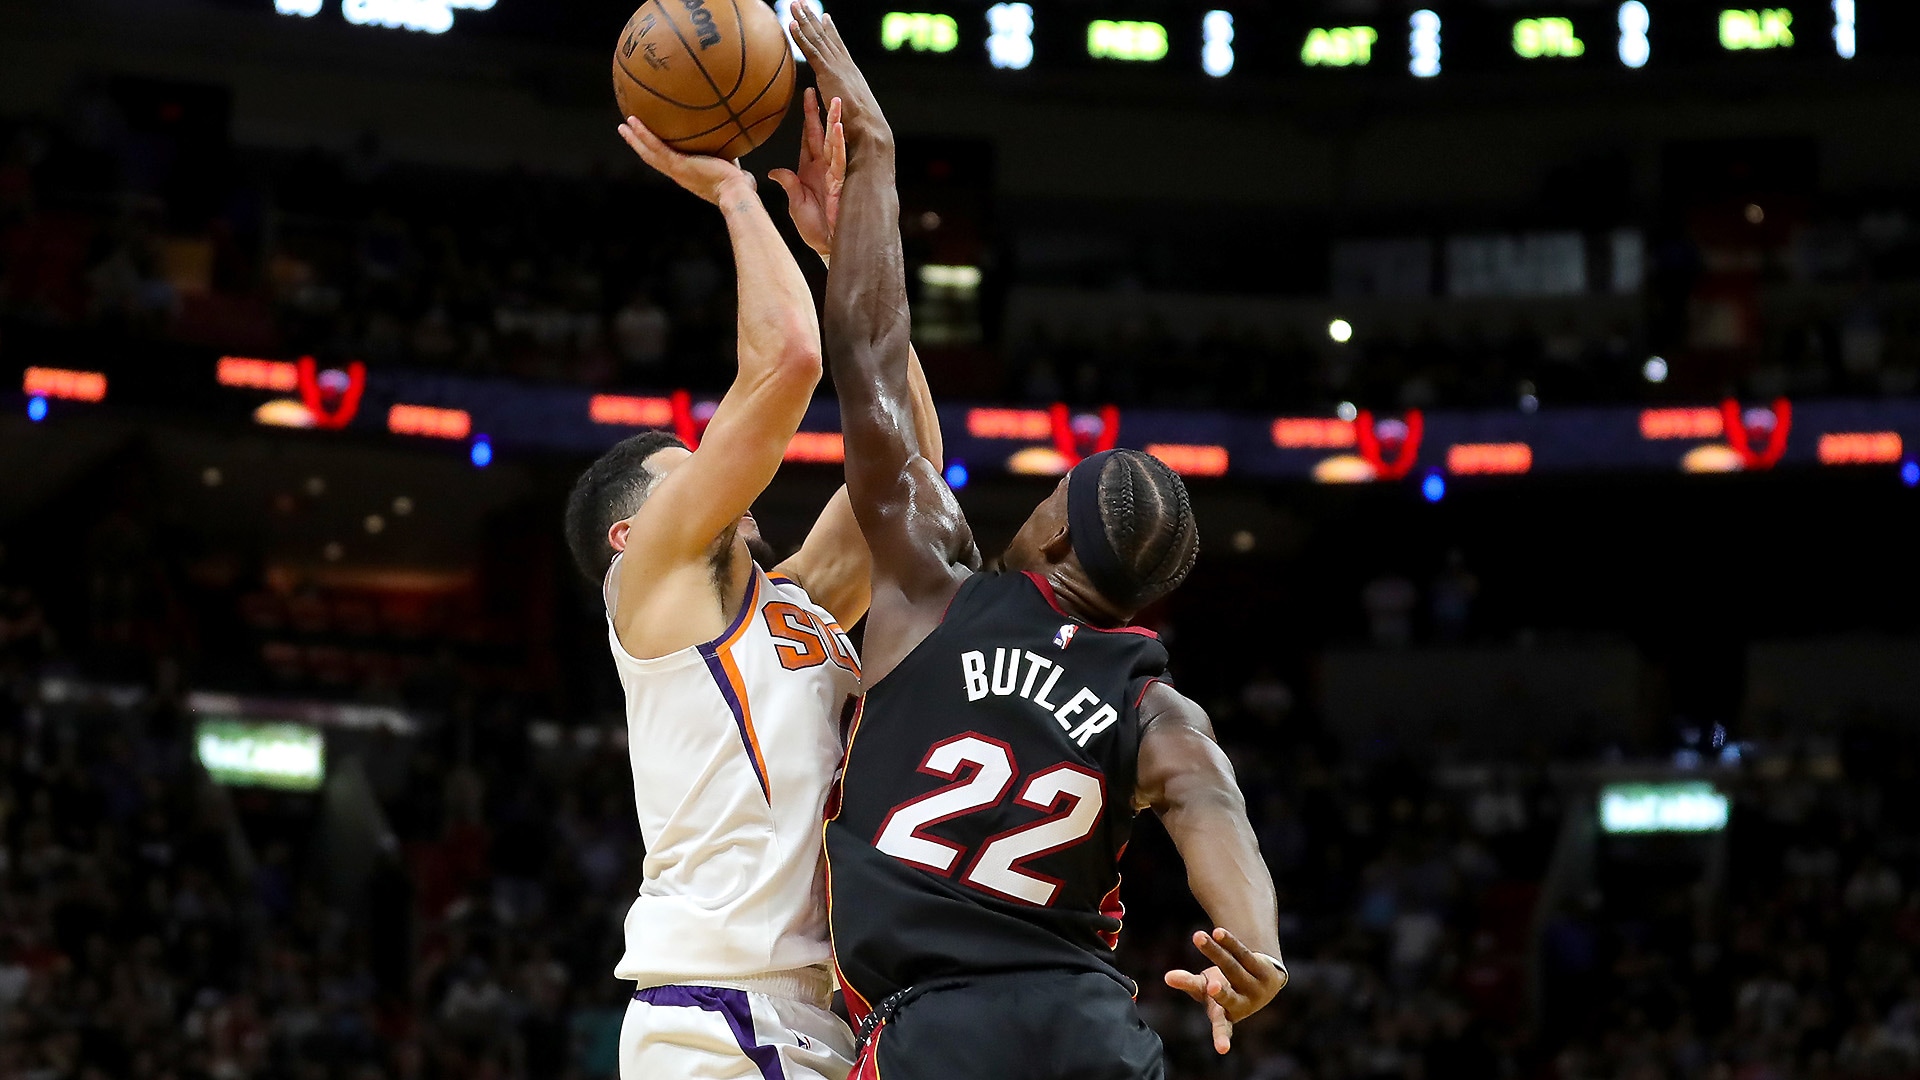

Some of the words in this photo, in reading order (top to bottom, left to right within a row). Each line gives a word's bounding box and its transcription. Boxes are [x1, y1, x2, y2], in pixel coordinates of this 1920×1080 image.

[882, 12, 958, 52] PTS
[1301, 26, 1378, 66] AST
[961, 648, 1118, 748] BUTLER
[872, 731, 1105, 906] 22
